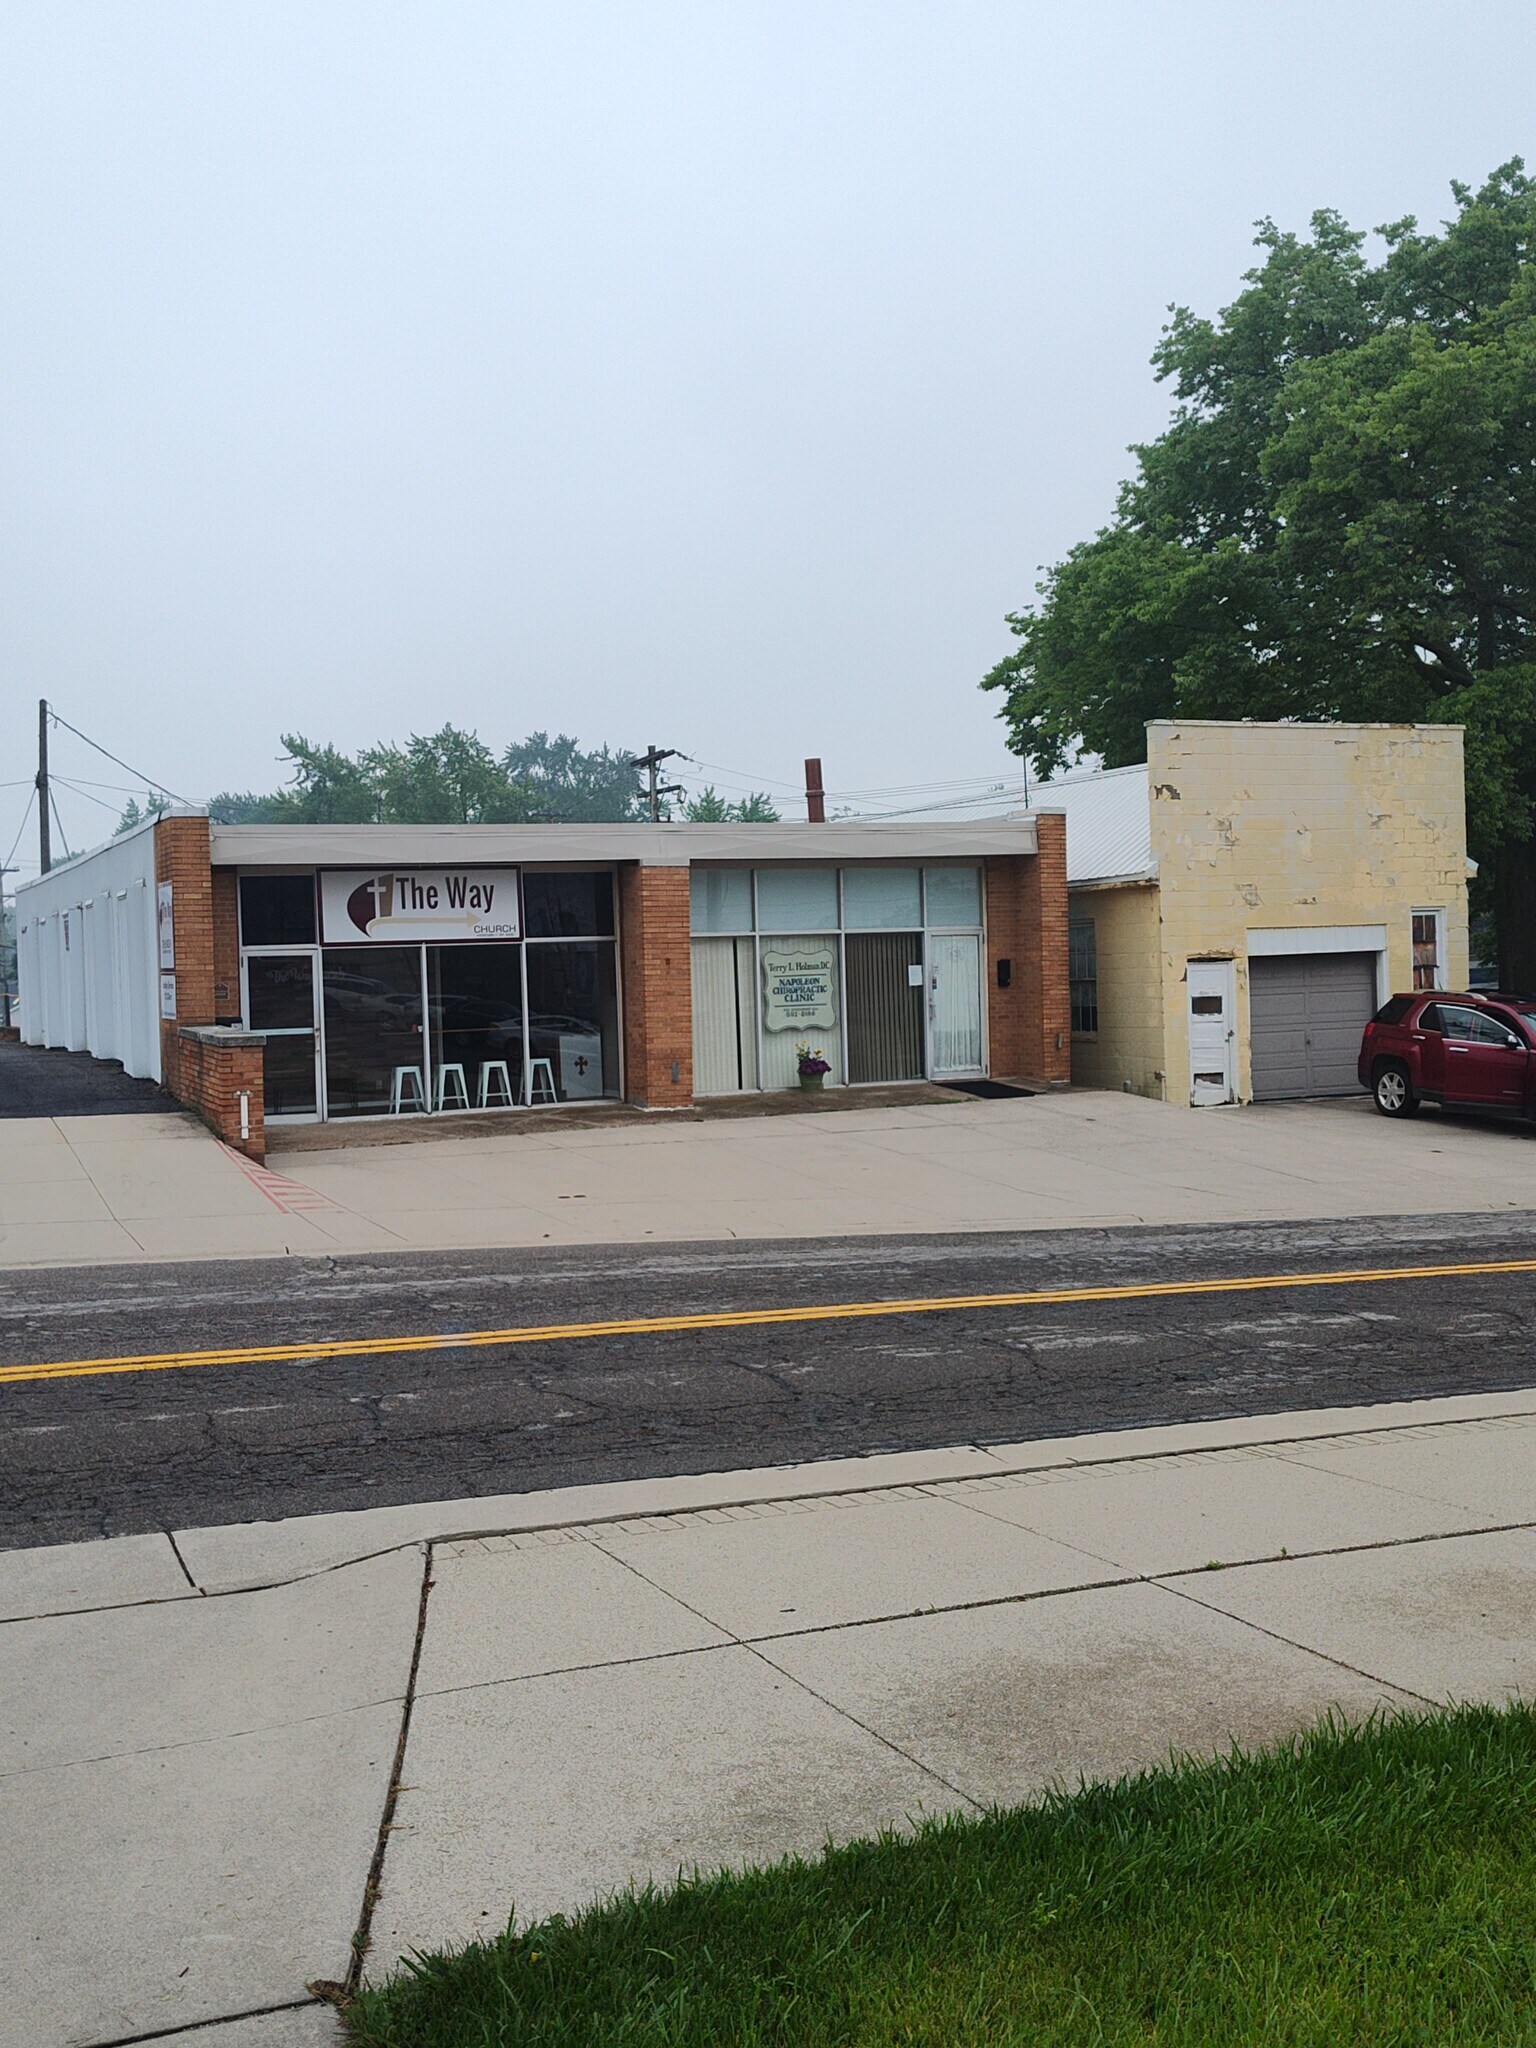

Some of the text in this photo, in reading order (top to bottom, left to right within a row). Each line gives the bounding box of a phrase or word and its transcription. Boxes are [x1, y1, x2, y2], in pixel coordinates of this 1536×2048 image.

[396, 876, 495, 914] The Way
[474, 924, 516, 933] CHURCH
[768, 963, 787, 974] Terry
[779, 977, 820, 986] NAPOLEON
[772, 985, 828, 995] CHIROPRACTIC
[784, 994, 815, 1002] CLINIC
